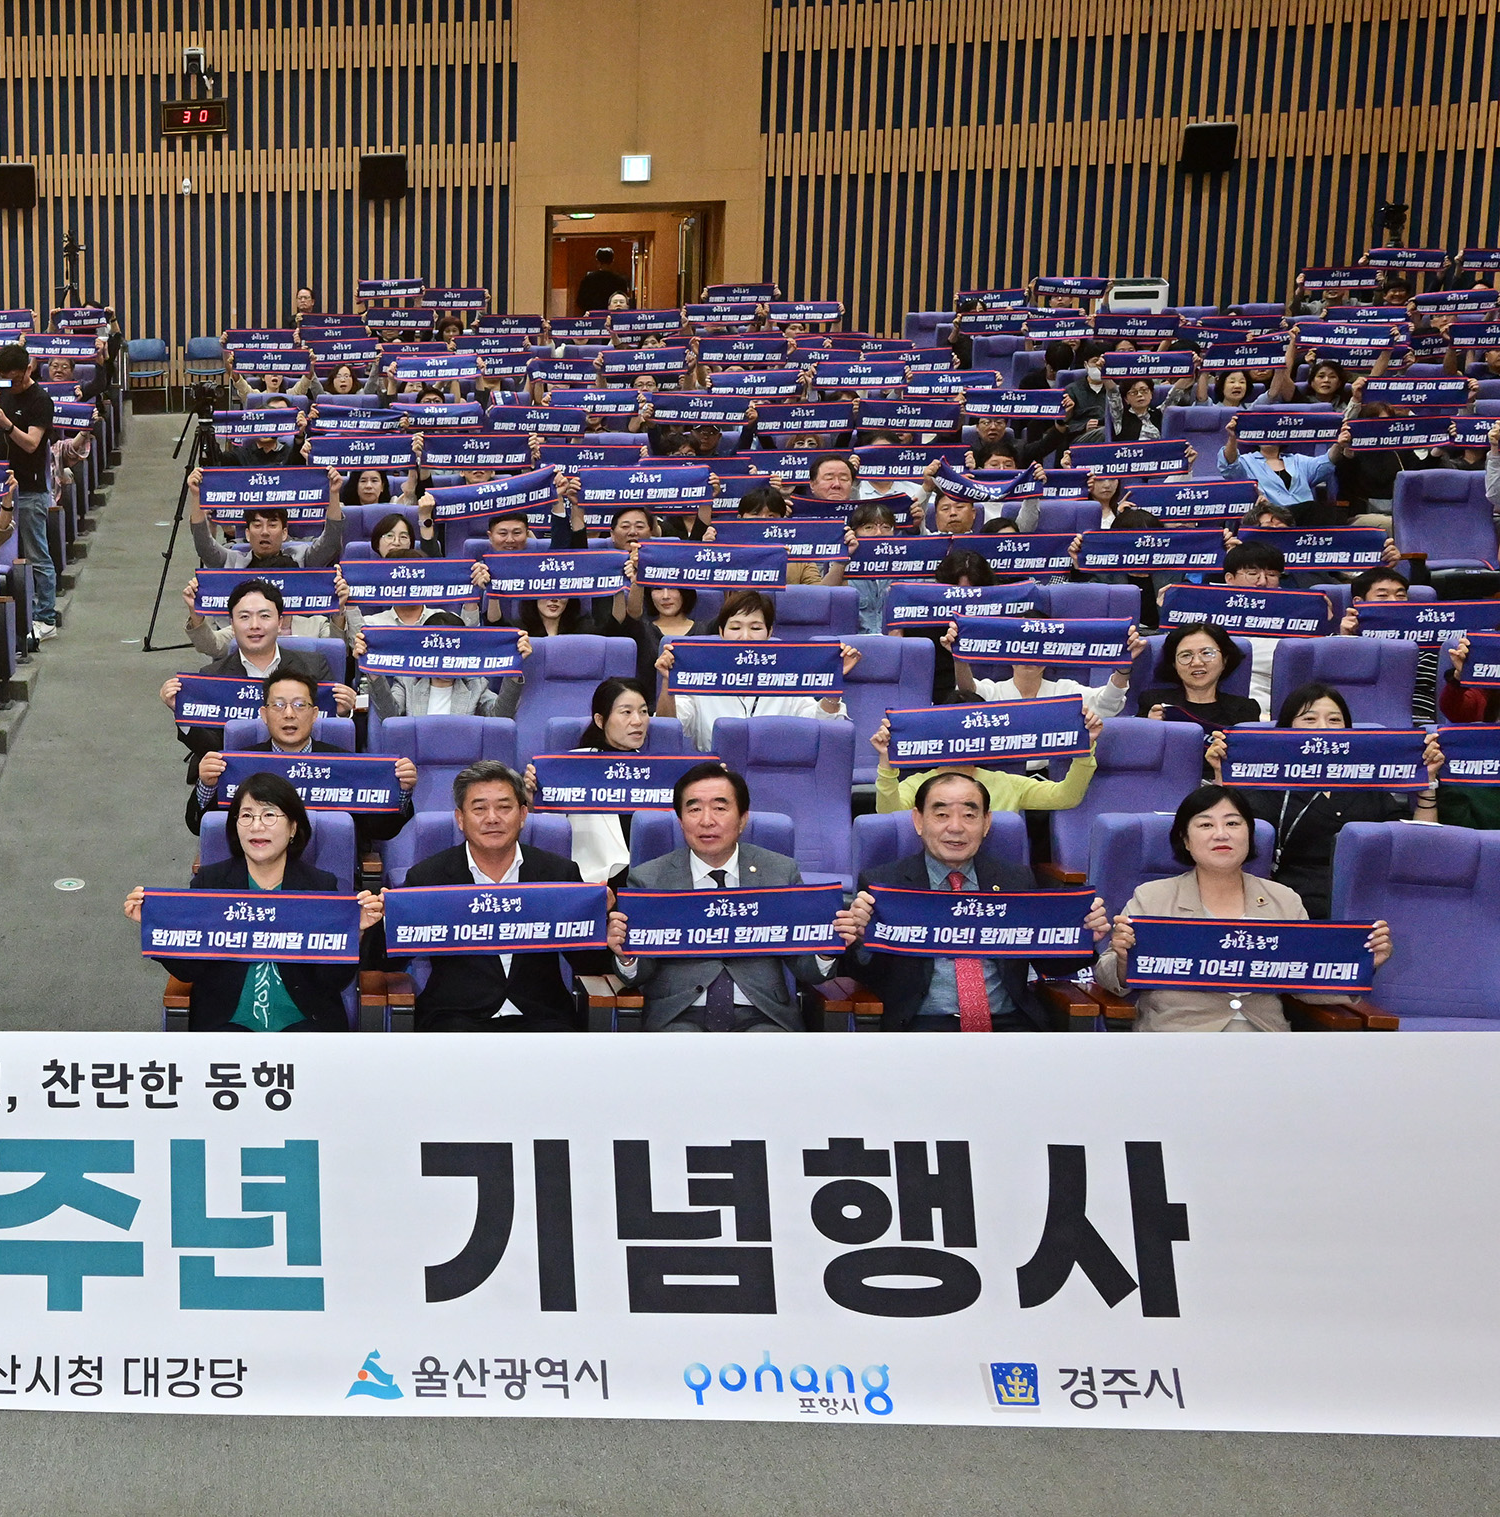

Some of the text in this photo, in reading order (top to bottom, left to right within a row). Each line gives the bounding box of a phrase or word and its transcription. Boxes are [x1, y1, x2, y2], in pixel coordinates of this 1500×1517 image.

[206, 489, 322, 502] 함께한 10년! 함께할 미래!
[367, 654, 513, 668] 함께한 10년! 함께할 미래!
[897, 731, 1078, 755] 함께한 10년! 함께할 미래!
[1231, 763, 1417, 778] 함께한 10년! 함께할 미래!
[152, 929, 347, 950] 함께한 10년! 함께할 미래!
[397, 920, 594, 942] 함께한 10년! 함께할 미래!
[629, 924, 834, 945] 함께한 10년! 함께할 미래!
[874, 922, 1080, 944] 함께한 10년! 함께할 미래!
[1137, 956, 1359, 980] 함께한 10년! 함께할 미래!
[42, 1059, 182, 1109] 찬란한
[205, 1061, 296, 1111] 동행
[421, 1138, 1190, 1318] 기념행사
[124, 1357, 248, 1398] 대강당
[411, 1356, 609, 1400] 울산광역시
[1058, 1367, 1186, 1410] 경주시
[798, 1397, 859, 1415] 포항시
